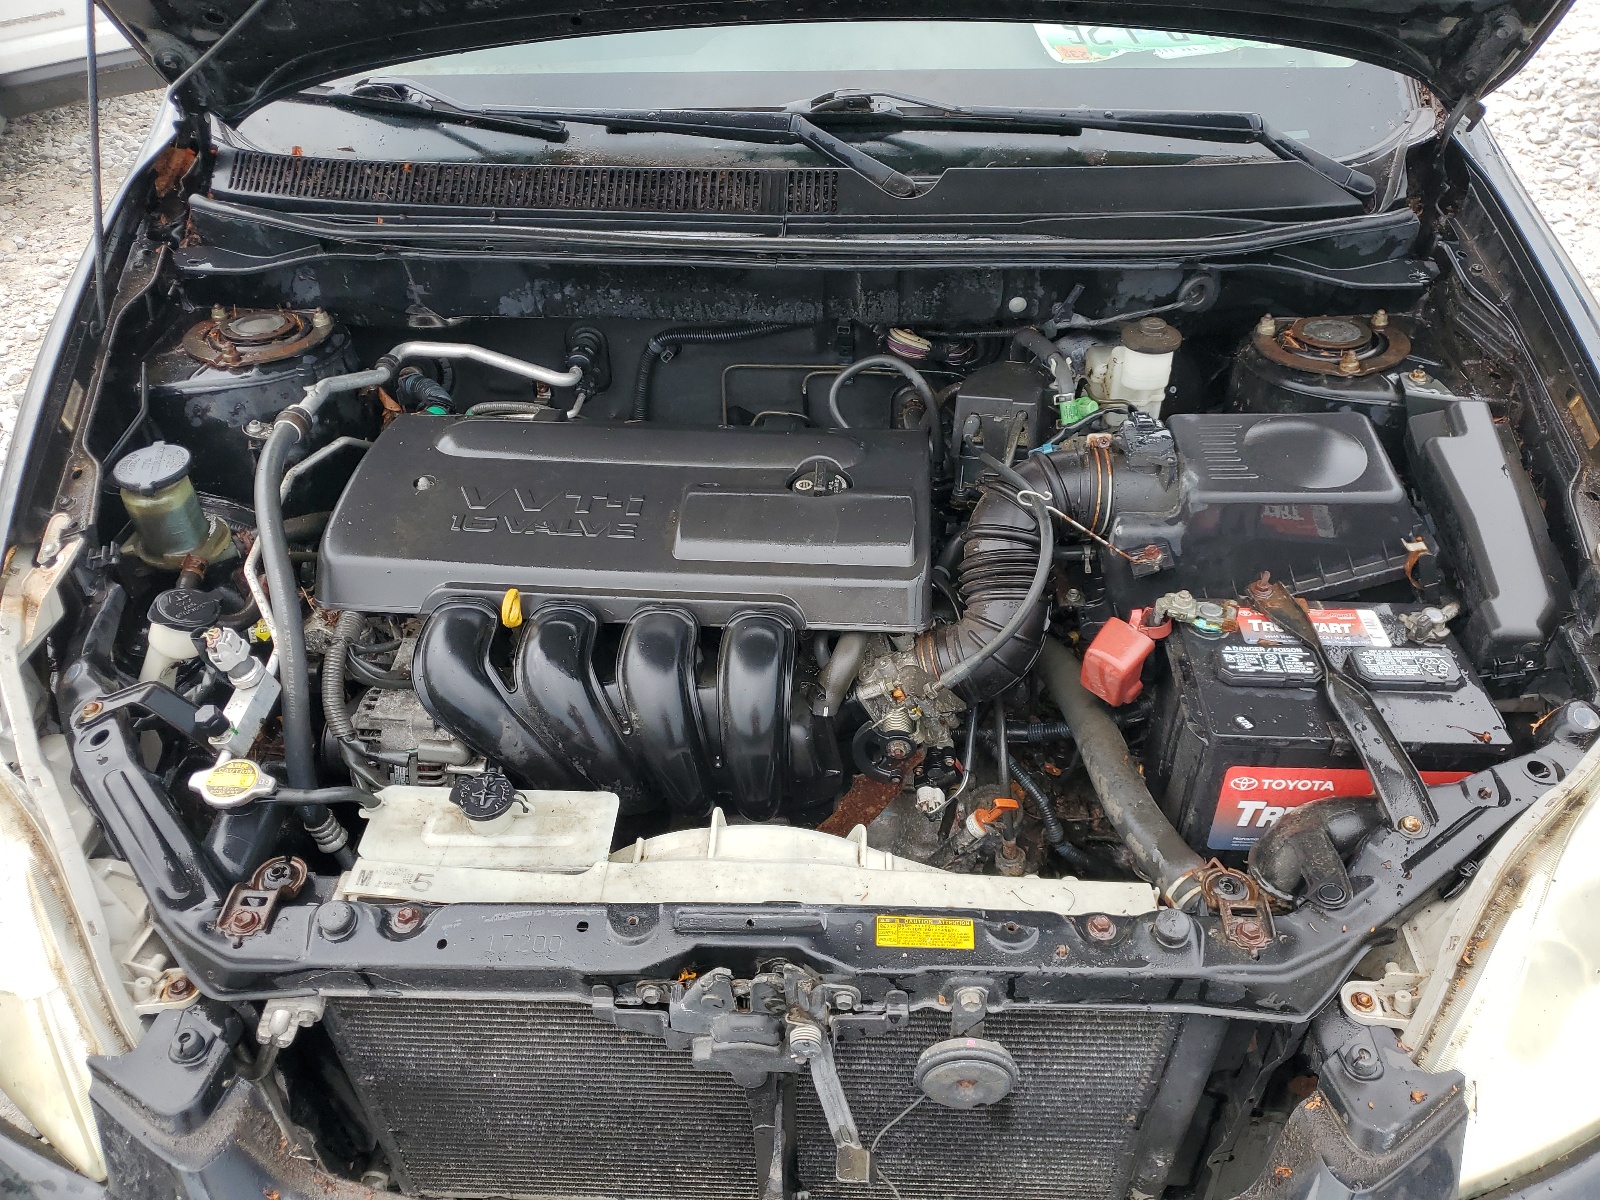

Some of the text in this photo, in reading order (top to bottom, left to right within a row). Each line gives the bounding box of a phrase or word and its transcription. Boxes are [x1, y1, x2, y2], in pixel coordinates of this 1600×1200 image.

[503, 515, 639, 540] VALVE
[1525, 660, 1534, 668] 2
[1261, 779, 1335, 792] TOYOTA
[355, 869, 374, 887] M
[410, 872, 435, 893] 5
